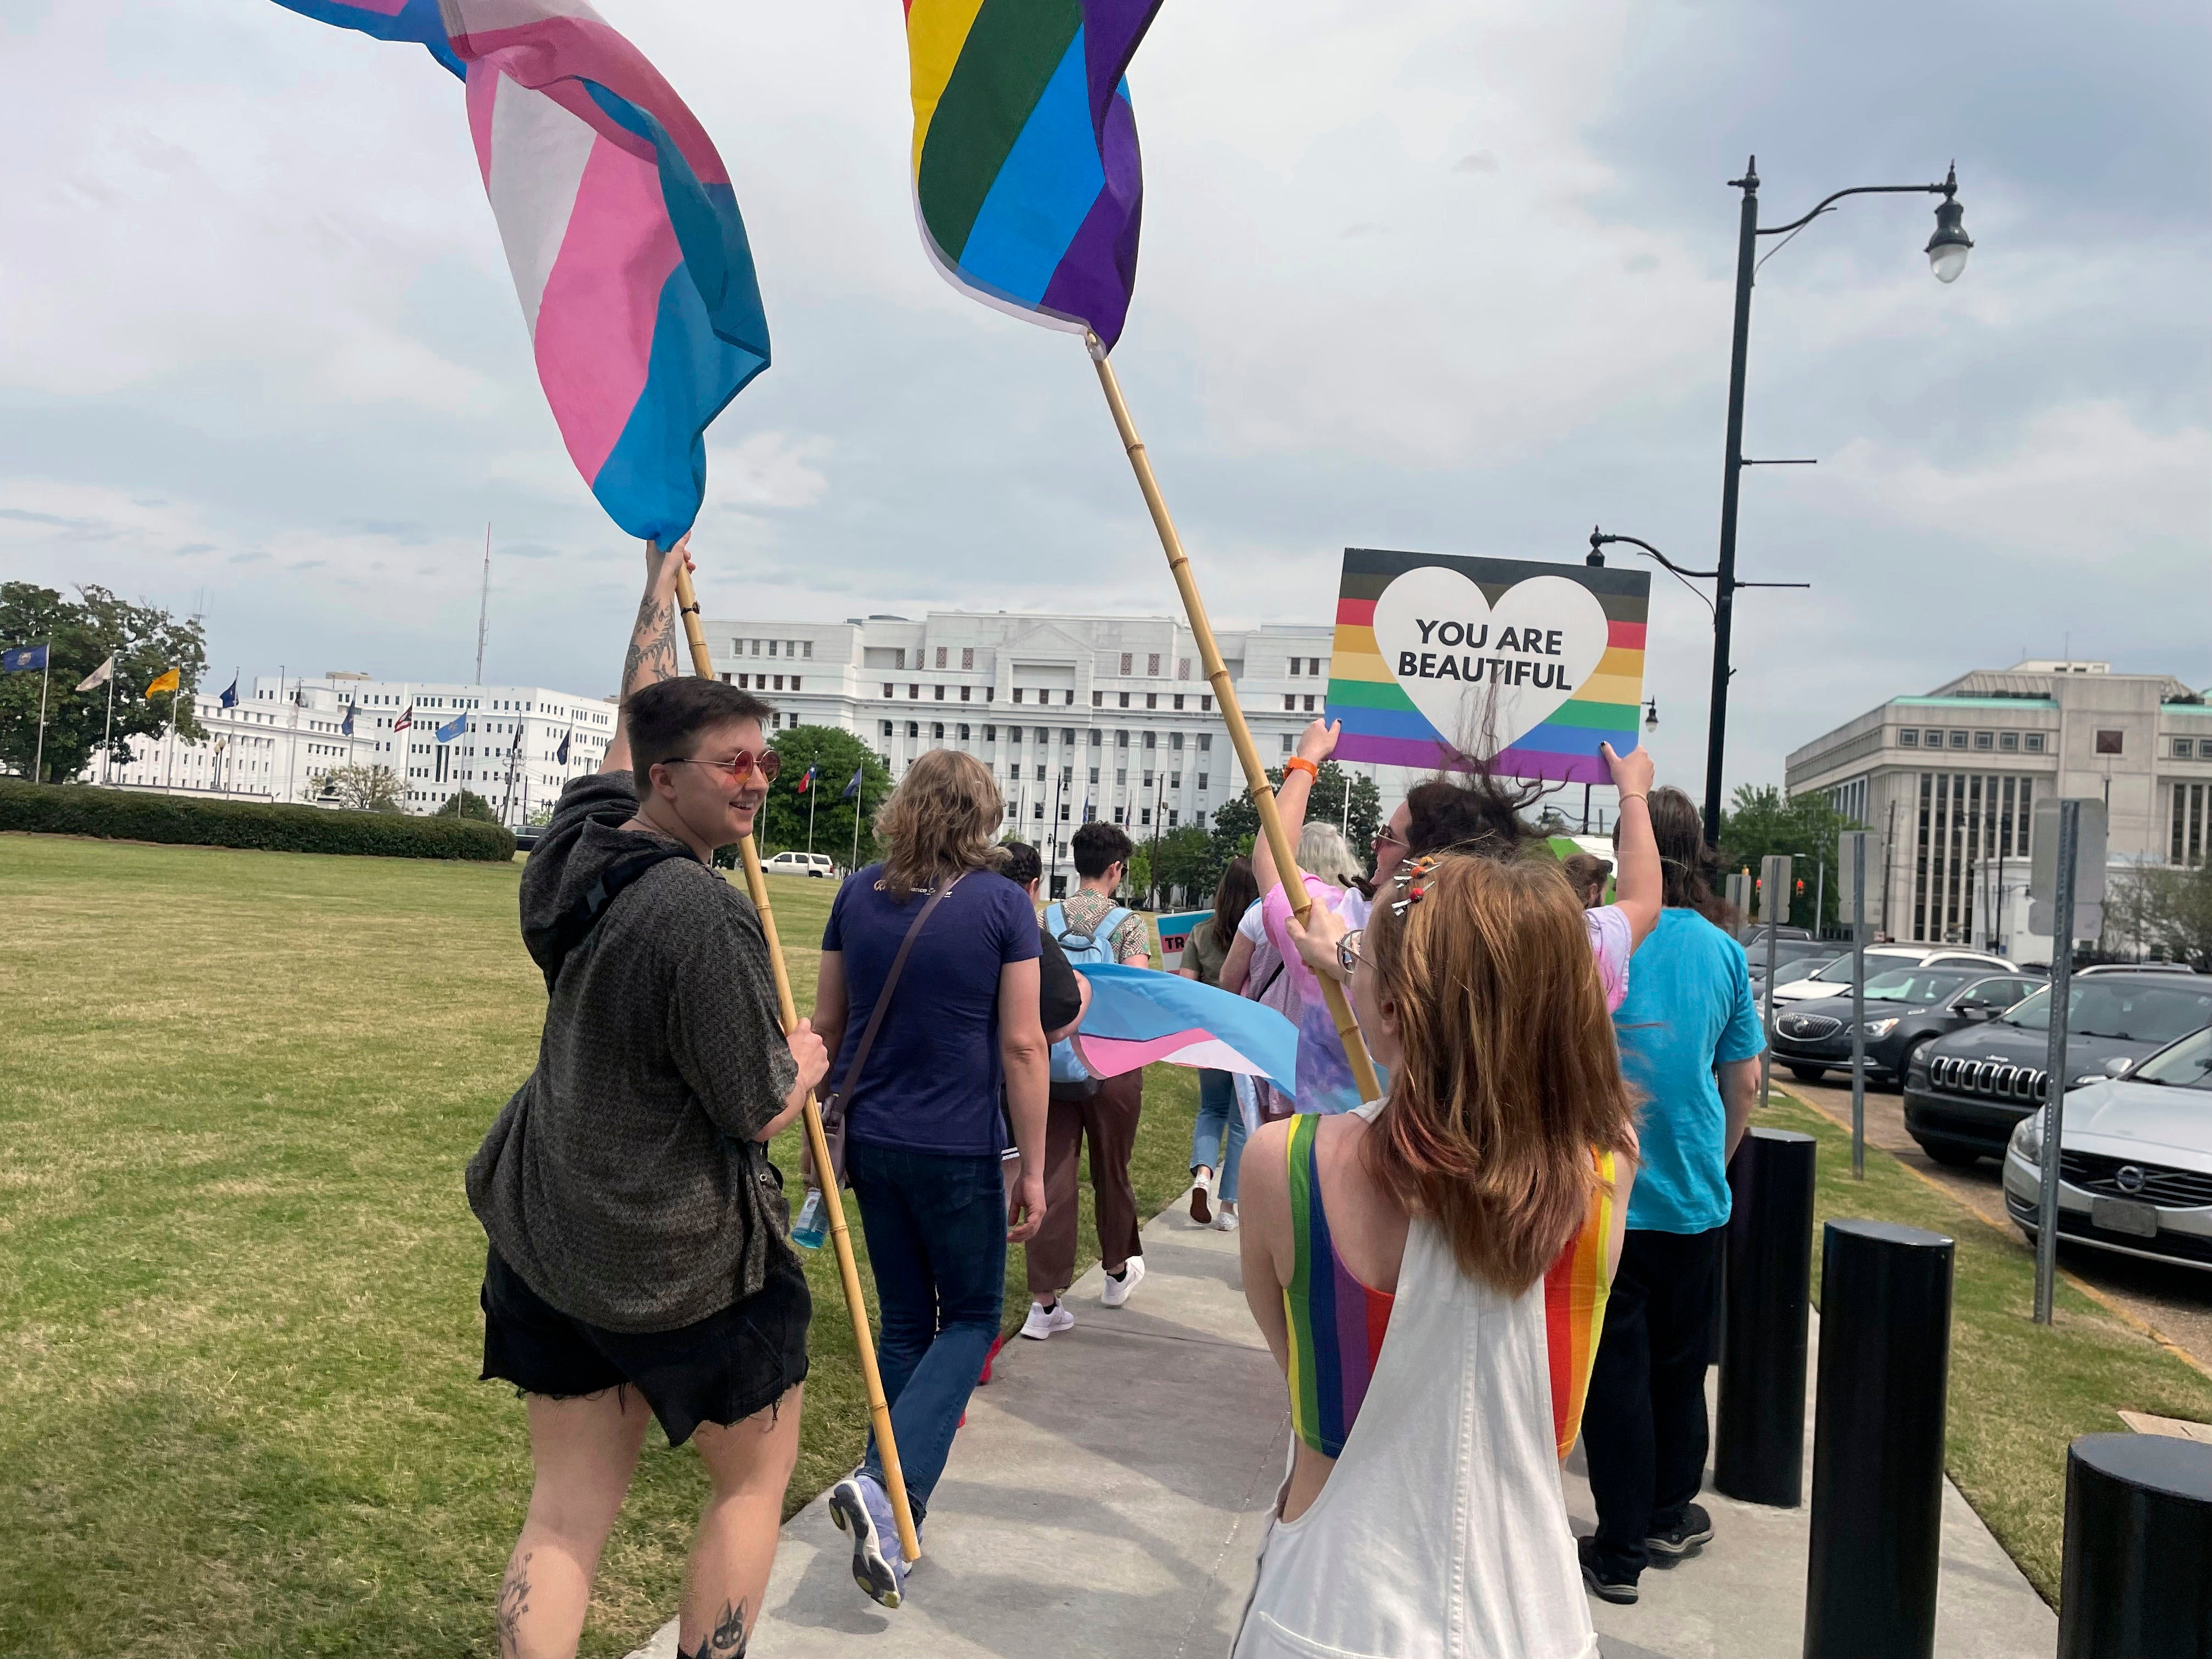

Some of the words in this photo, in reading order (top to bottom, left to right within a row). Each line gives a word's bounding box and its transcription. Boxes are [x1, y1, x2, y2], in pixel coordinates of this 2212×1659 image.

[1415, 619, 1488, 648] YOU
[1495, 627, 1562, 656] ARE
[1398, 651, 1572, 691] BEAUTIFUL
